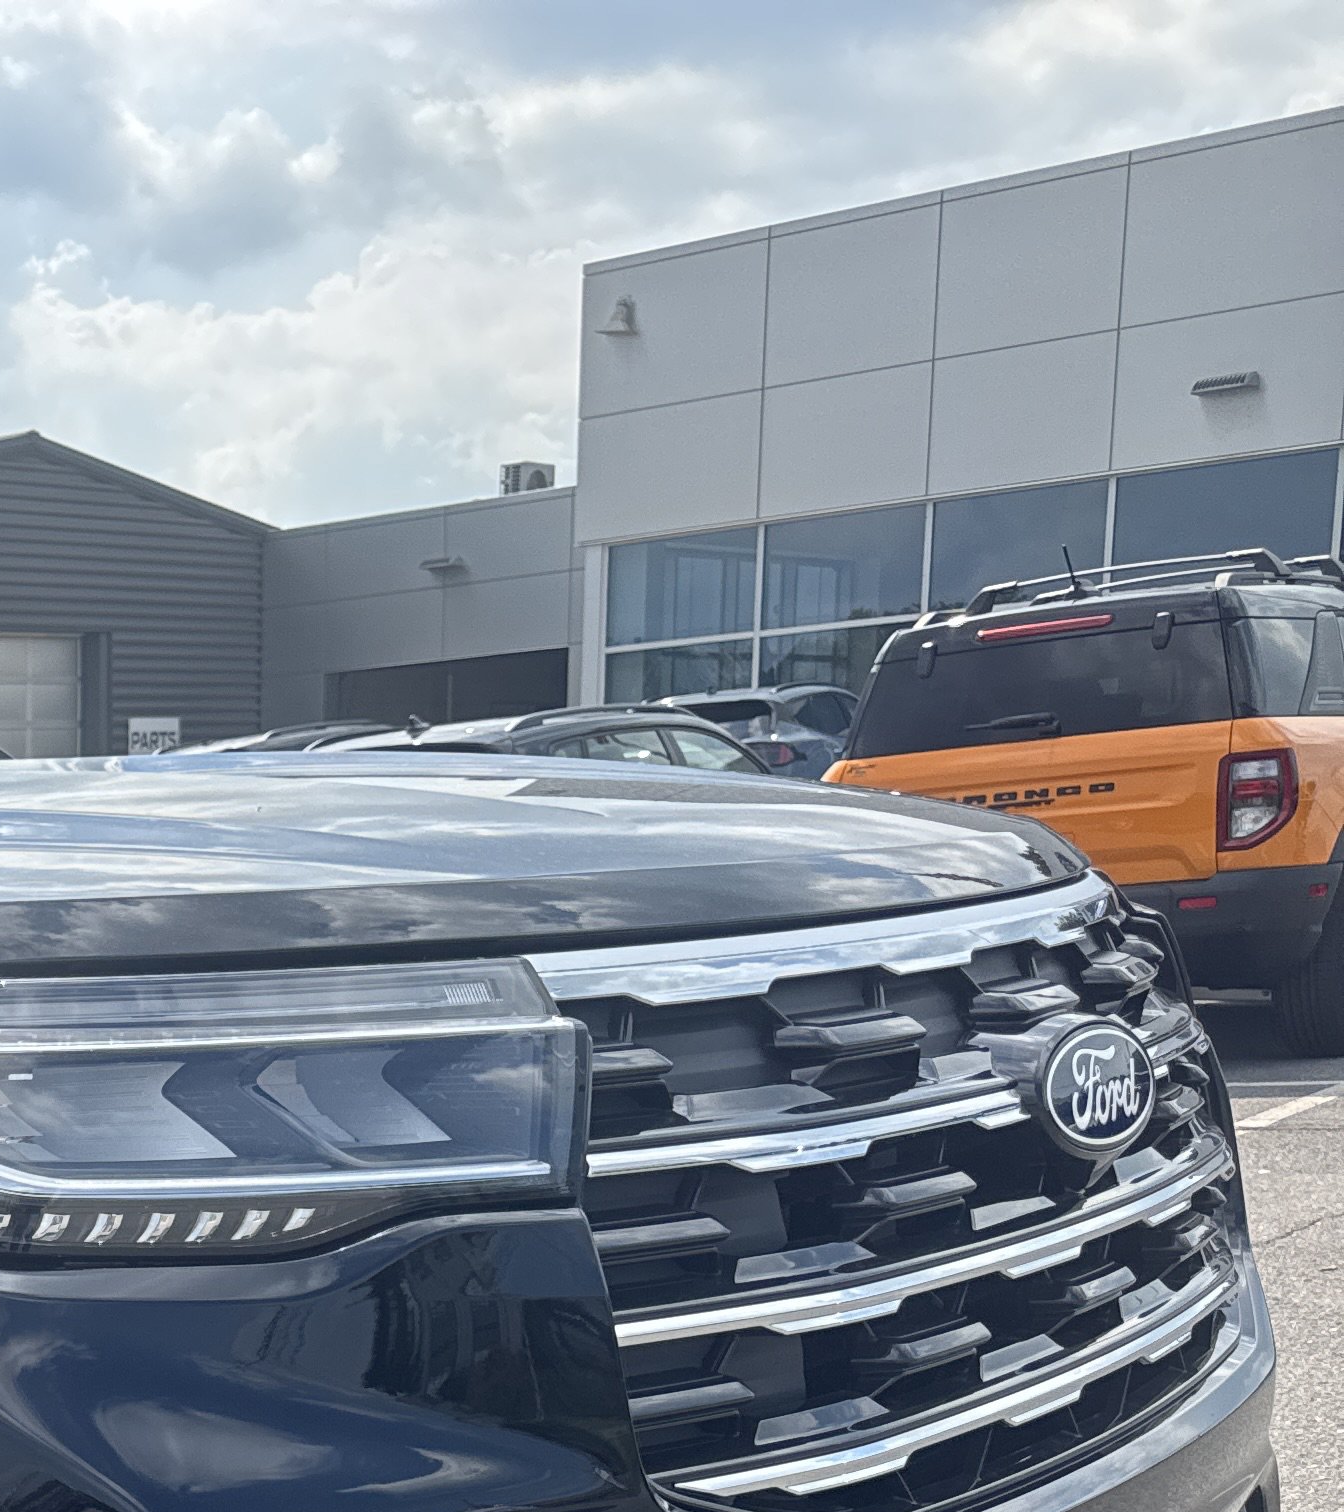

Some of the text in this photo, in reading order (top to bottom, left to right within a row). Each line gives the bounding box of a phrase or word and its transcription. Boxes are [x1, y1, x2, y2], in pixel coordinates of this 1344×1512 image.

[131, 732, 176, 750] PARTS
[944, 782, 1115, 806] RONCO
[1072, 1045, 1140, 1130] Ford
